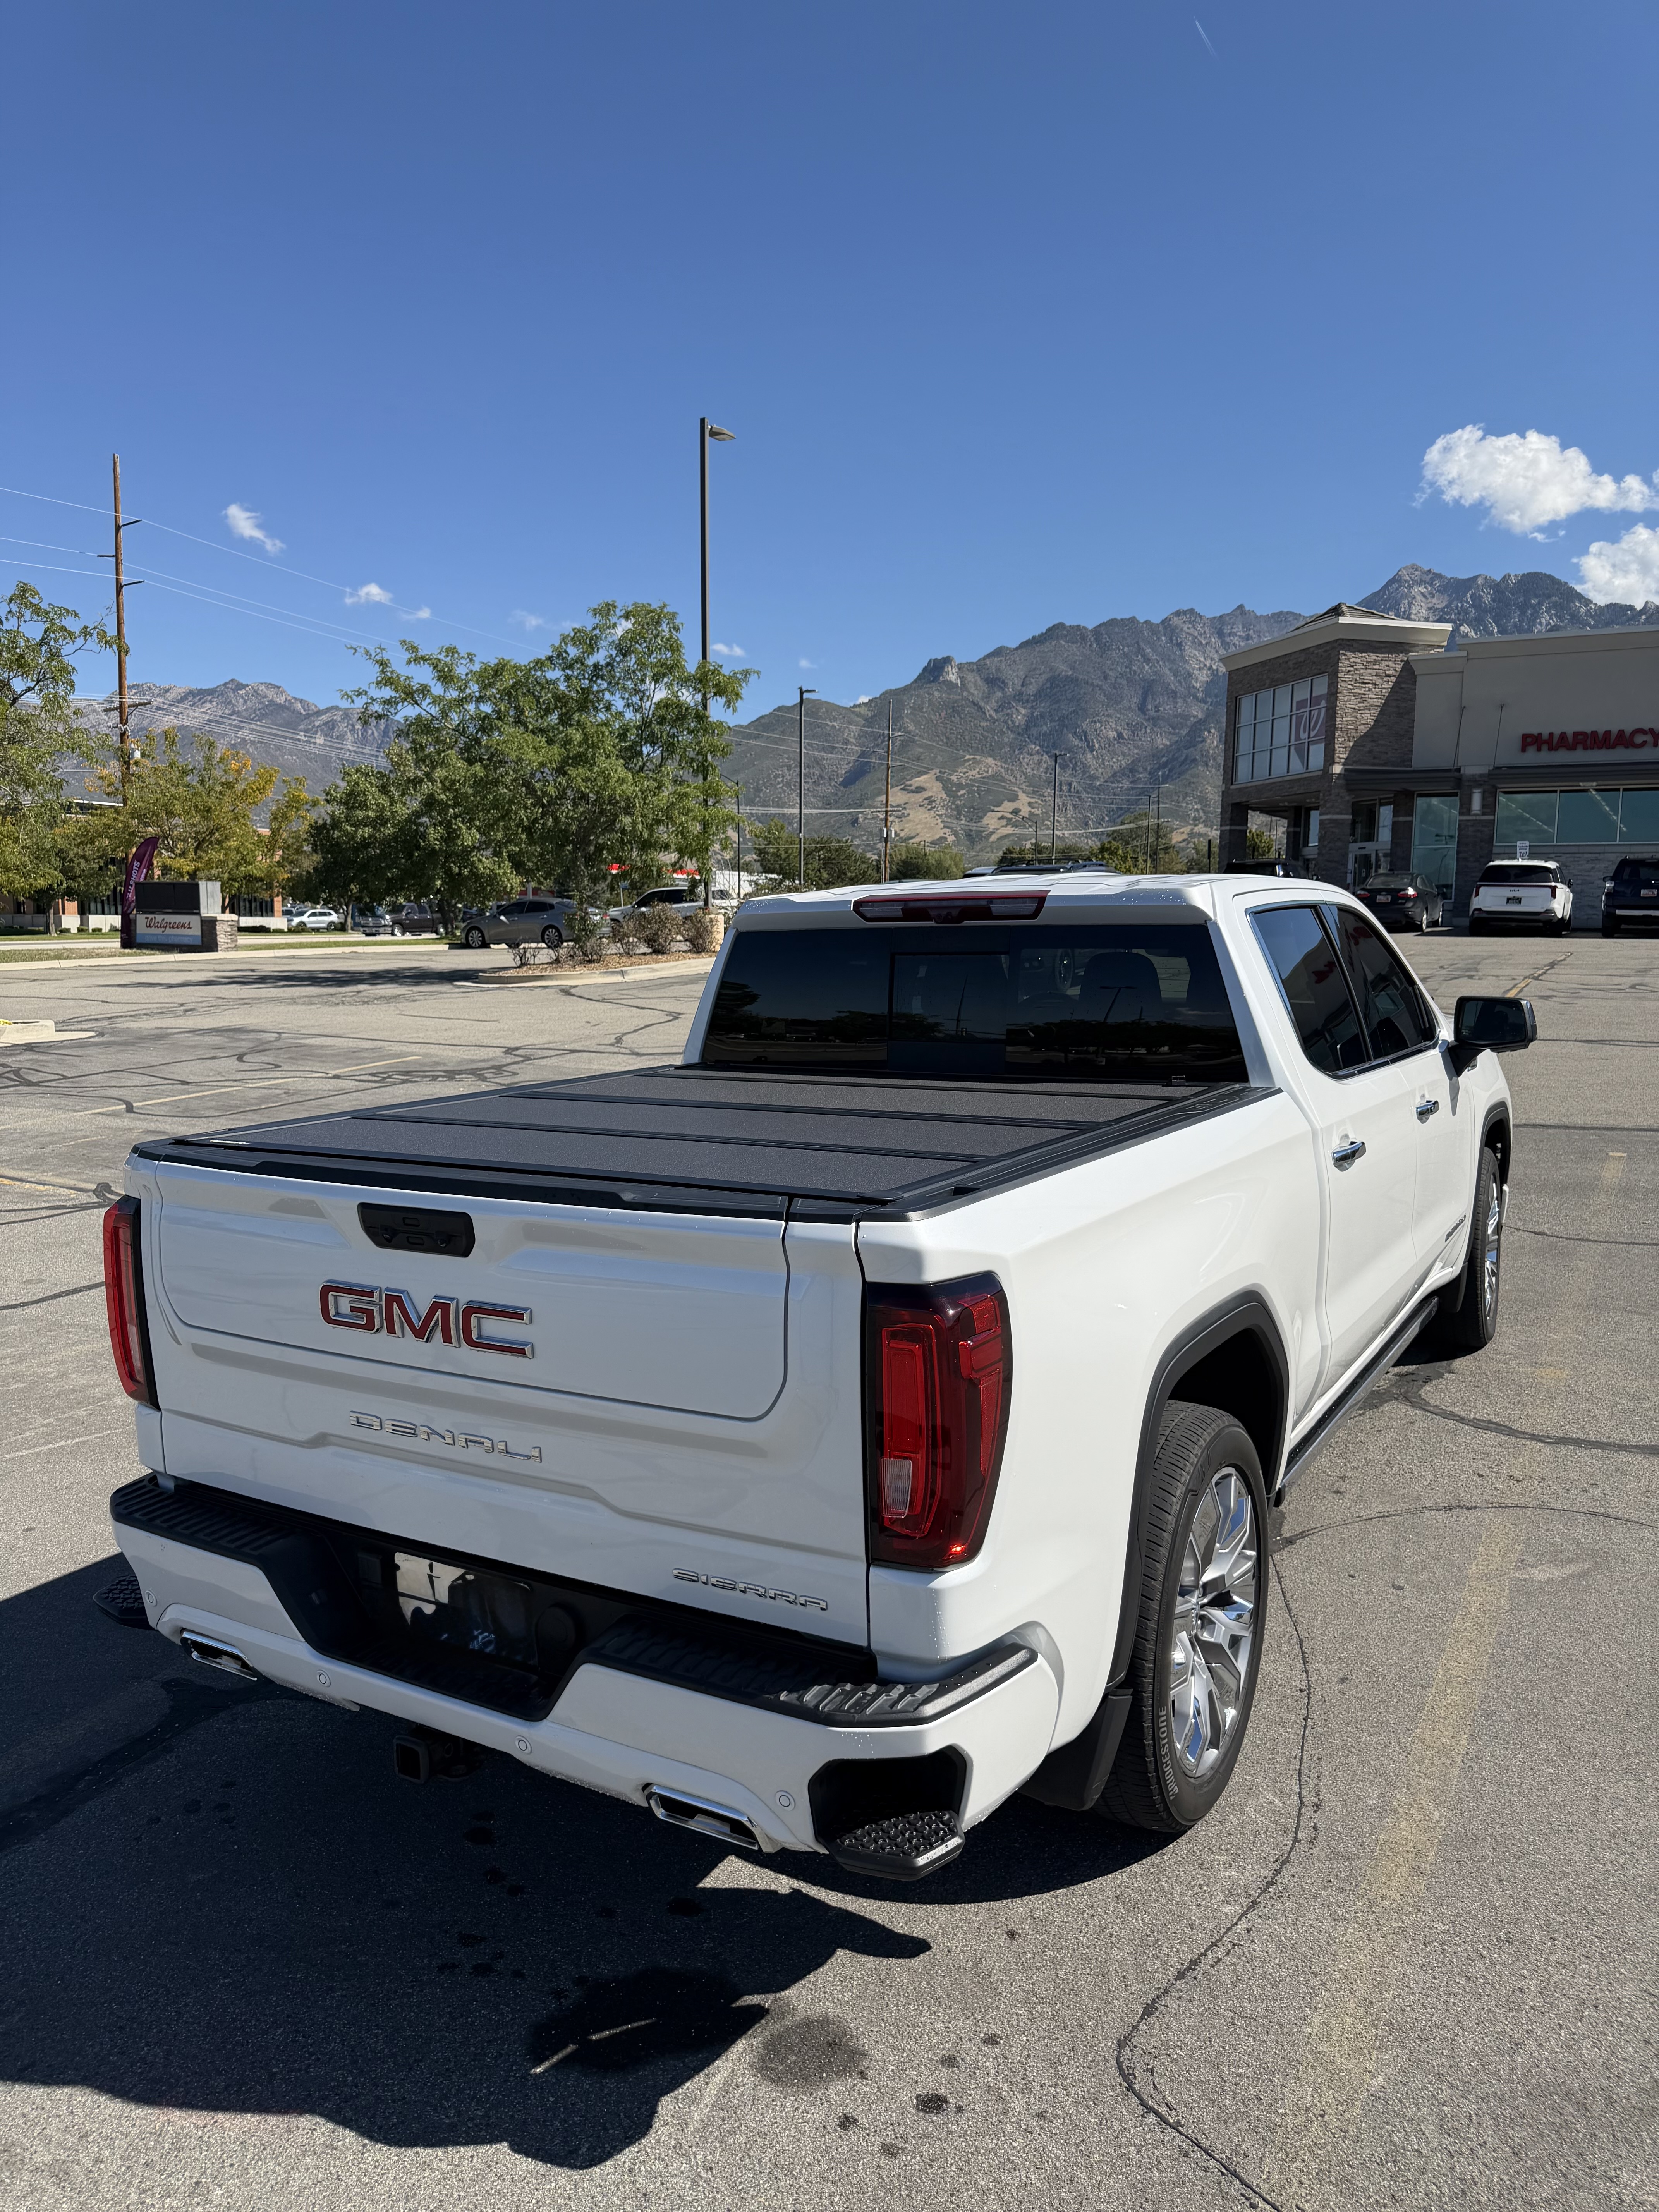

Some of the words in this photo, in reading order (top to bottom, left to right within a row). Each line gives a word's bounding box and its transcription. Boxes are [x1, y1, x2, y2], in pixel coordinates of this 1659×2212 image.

[1521, 728, 1659, 752] PHARMACY
[130, 860, 140, 886] SHOTS
[145, 916, 192, 933] Walgreens
[319, 1279, 534, 1360] GMC
[349, 1410, 541, 1463] DENALI
[672, 1568, 828, 1611] SIERRA
[1158, 1706, 1179, 1801] BRIDGESTONE
